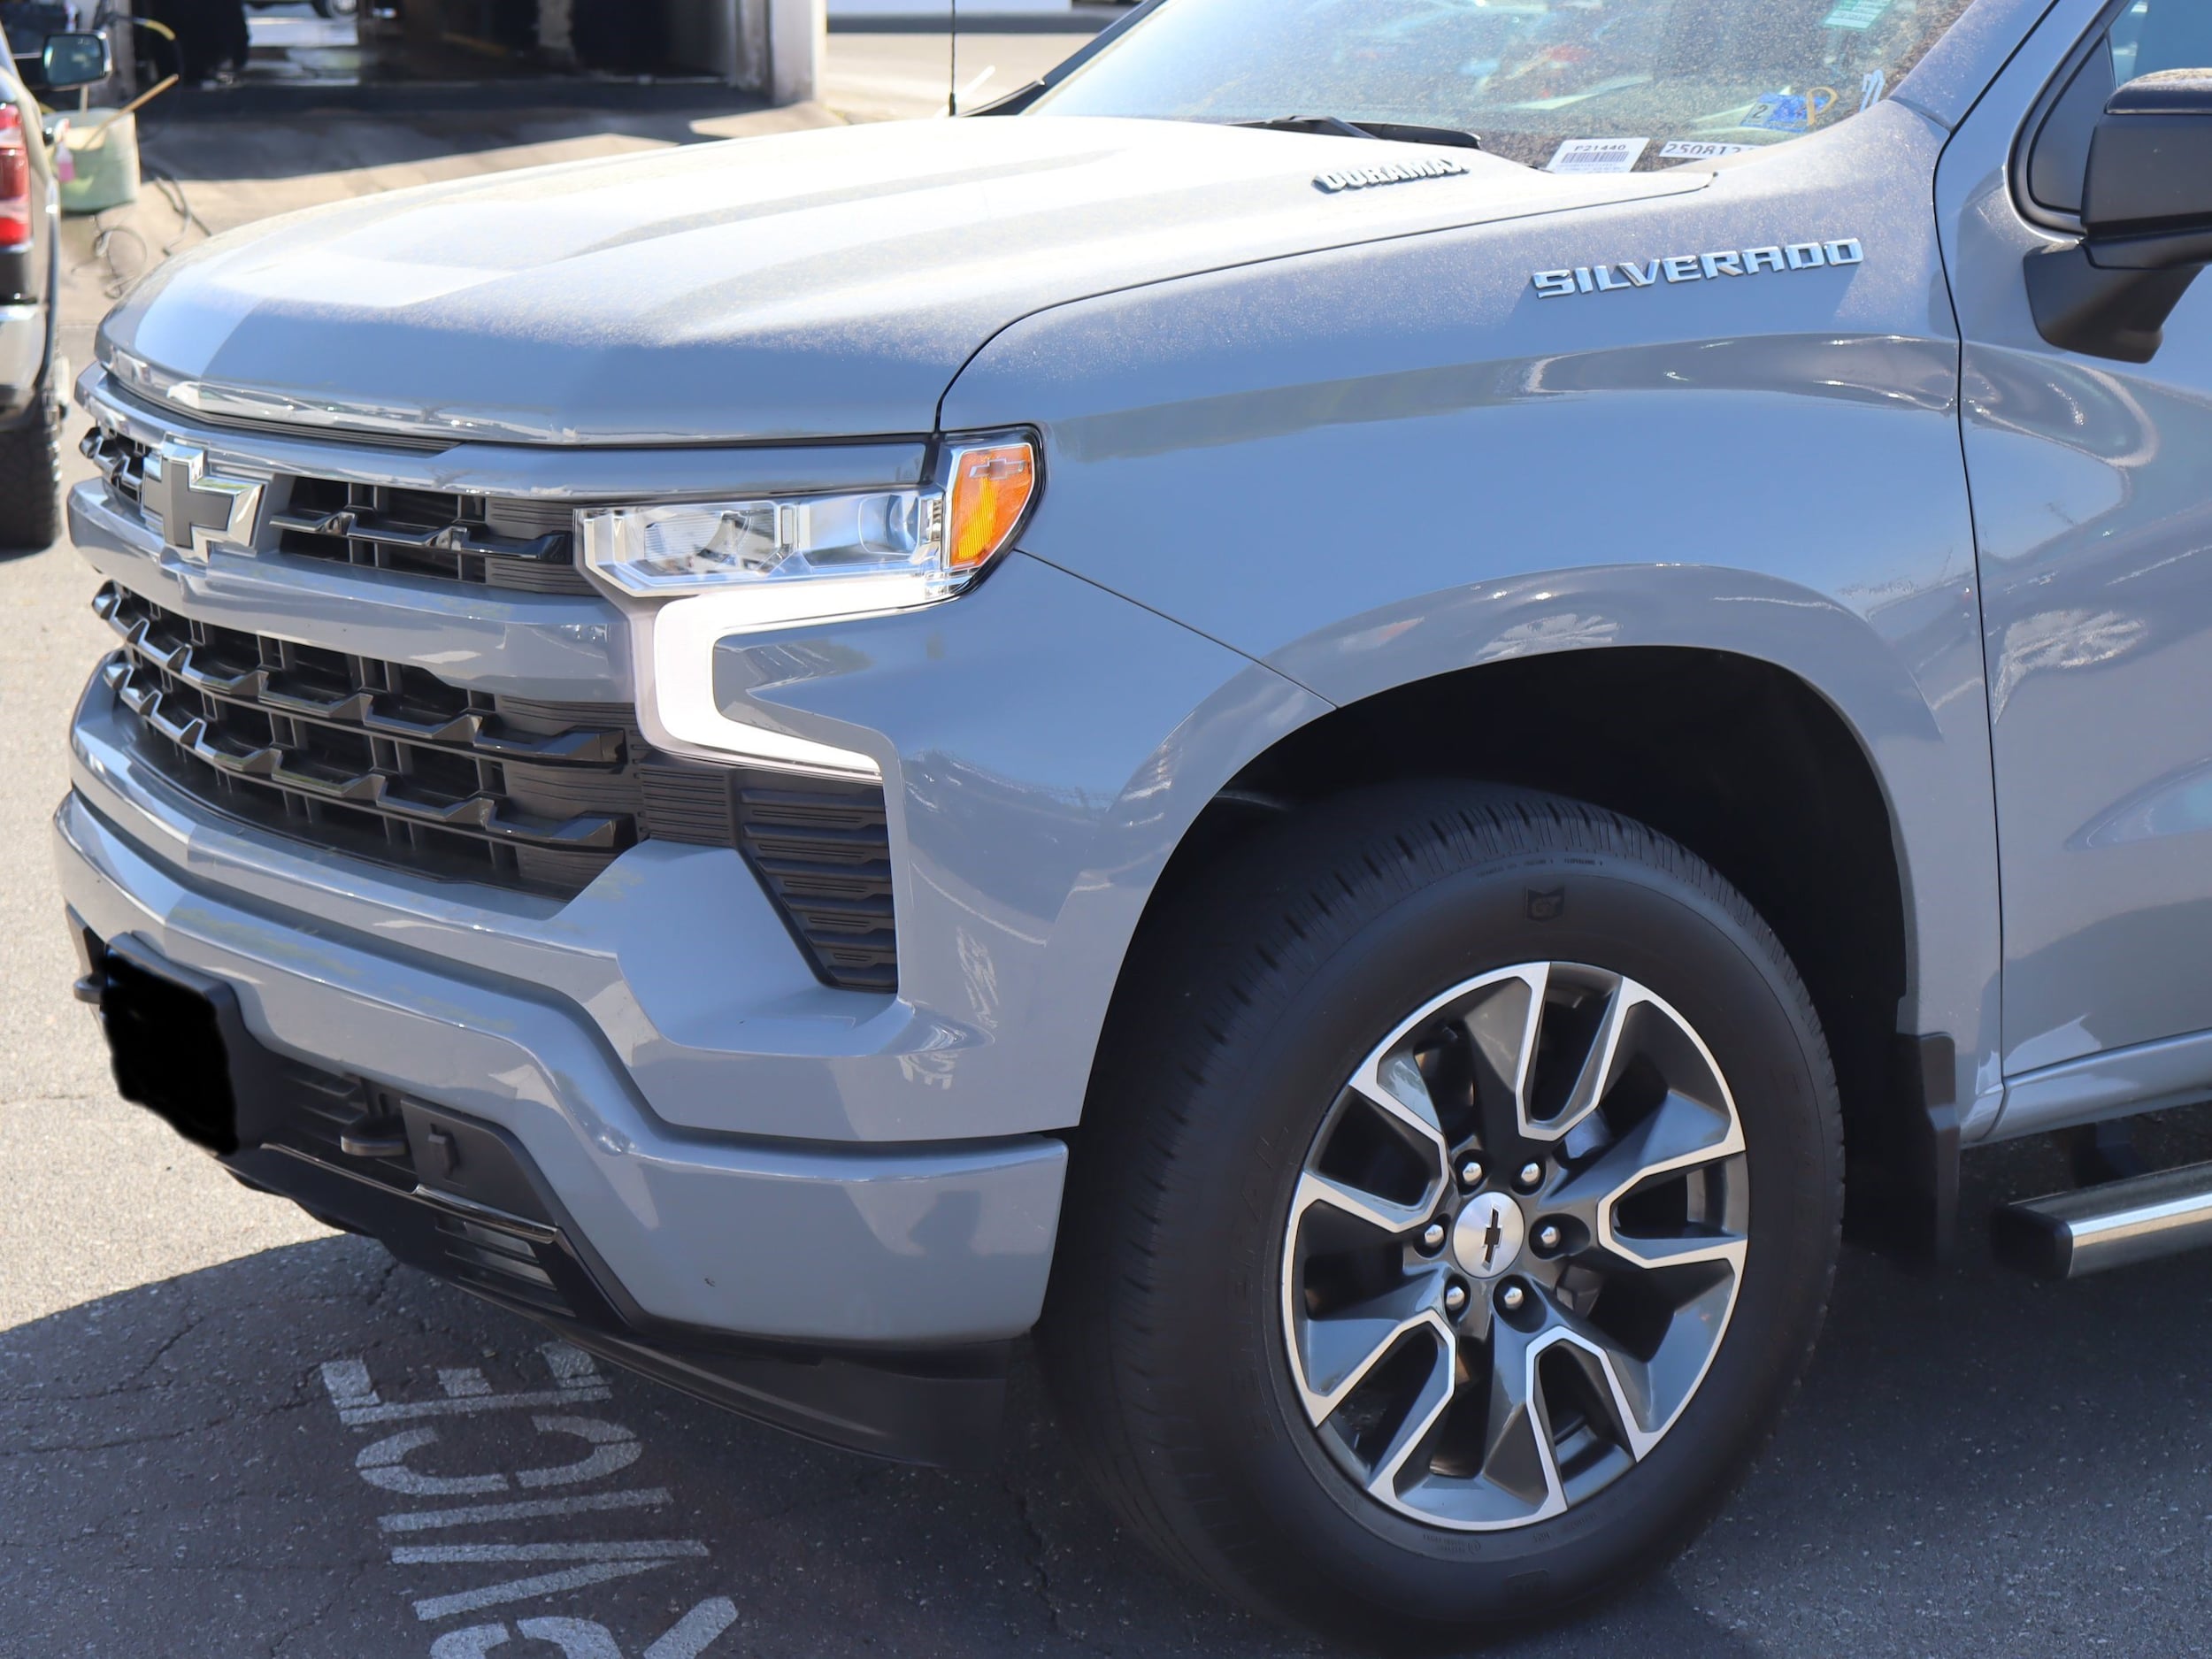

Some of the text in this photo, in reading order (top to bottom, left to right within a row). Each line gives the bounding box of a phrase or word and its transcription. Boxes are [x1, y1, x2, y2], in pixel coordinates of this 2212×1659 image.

[1752, 104, 1768, 119] 2
[1311, 157, 1471, 195] DURAMAX
[1532, 237, 1864, 299] SILVERADO
